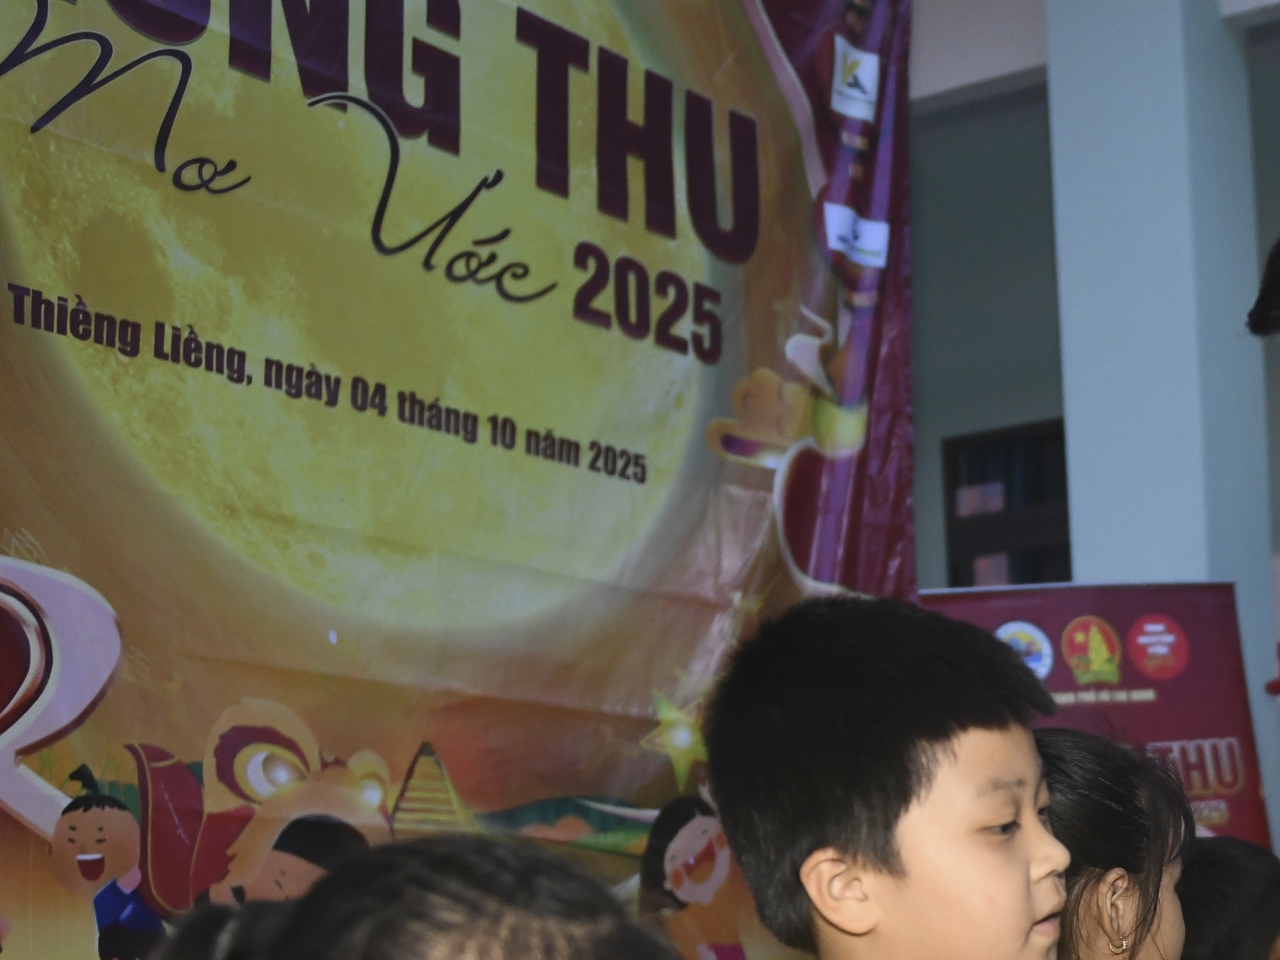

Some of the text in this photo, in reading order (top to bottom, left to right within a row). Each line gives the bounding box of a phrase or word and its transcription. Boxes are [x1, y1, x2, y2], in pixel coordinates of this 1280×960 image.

[515, 7, 761, 264] THU
[7, 282, 142, 359] Thiềng
[263, 356, 342, 409] ngày
[350, 375, 389, 418] 04
[396, 389, 480, 445] tháng
[487, 413, 518, 451] 10
[524, 427, 582, 468] năm
[587, 439, 648, 485] 2025
[572, 241, 724, 366] 2025
